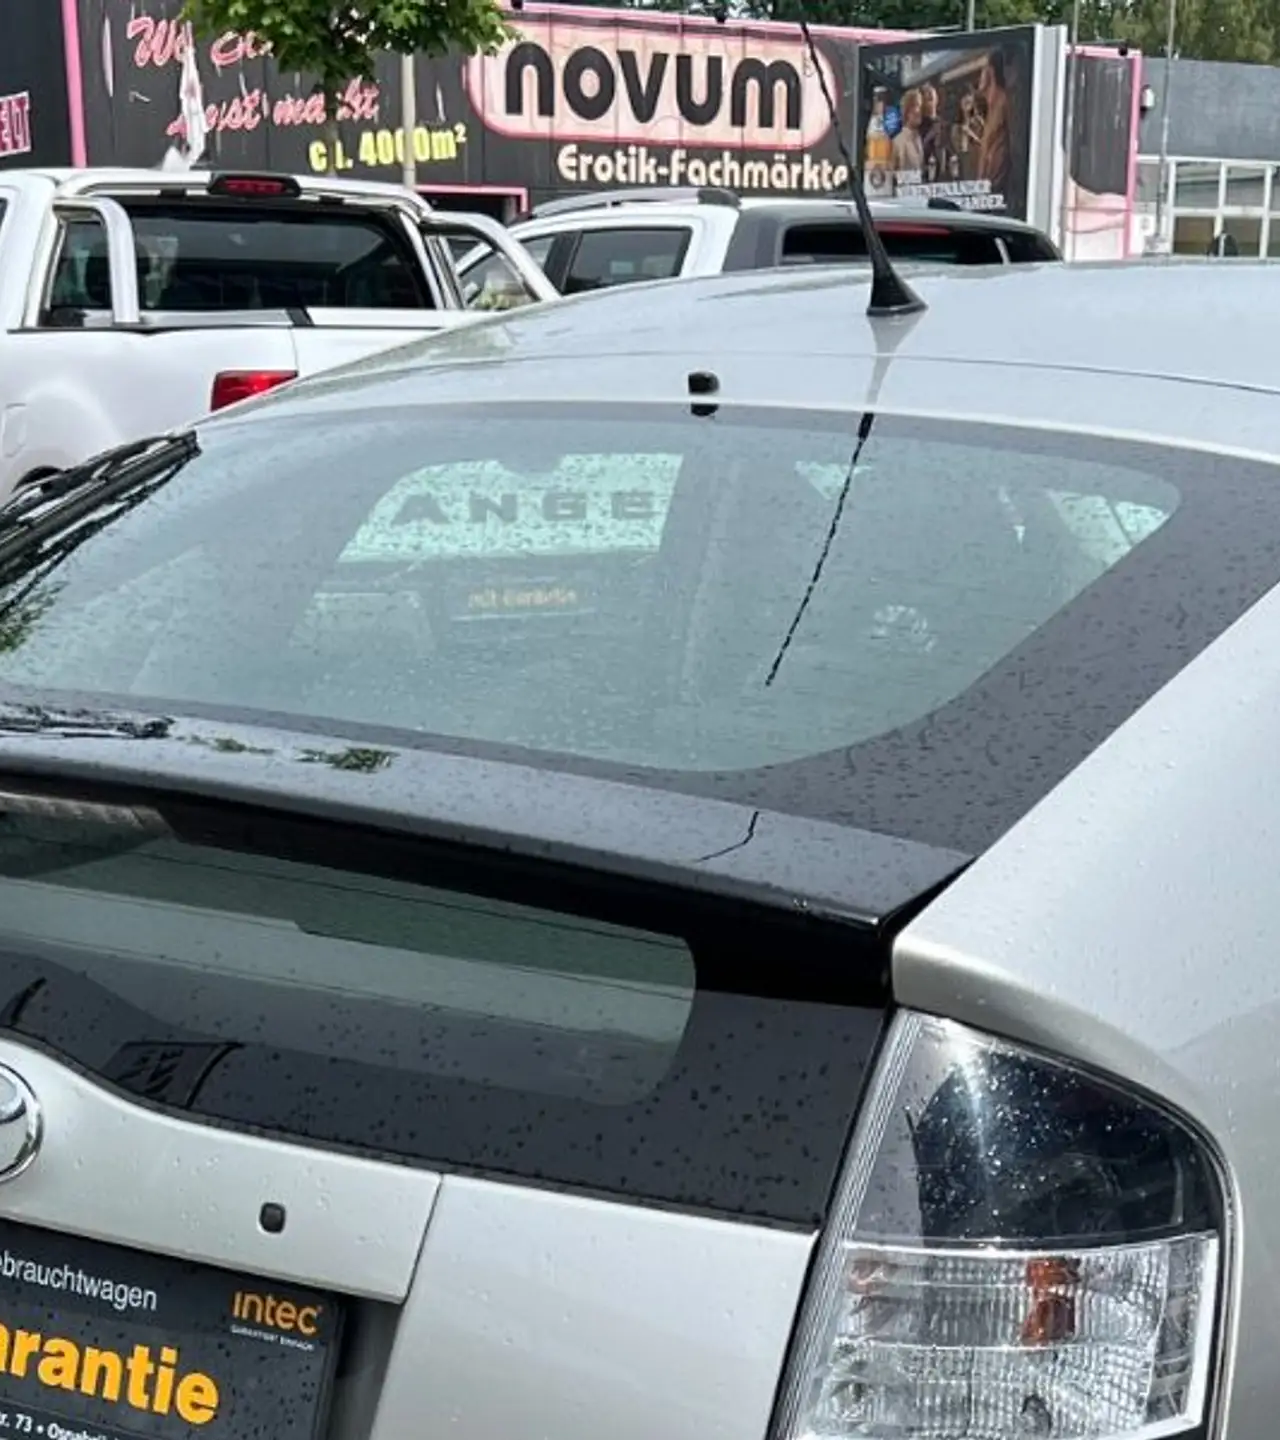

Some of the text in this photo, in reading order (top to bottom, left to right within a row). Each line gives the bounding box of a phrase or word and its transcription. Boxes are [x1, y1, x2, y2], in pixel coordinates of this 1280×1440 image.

[506, 41, 803, 130] novum
[557, 144, 850, 191] Erotik-Fachmärkte
[233, 1291, 317, 1336] intec
[15, 1413, 34, 1433] 73
